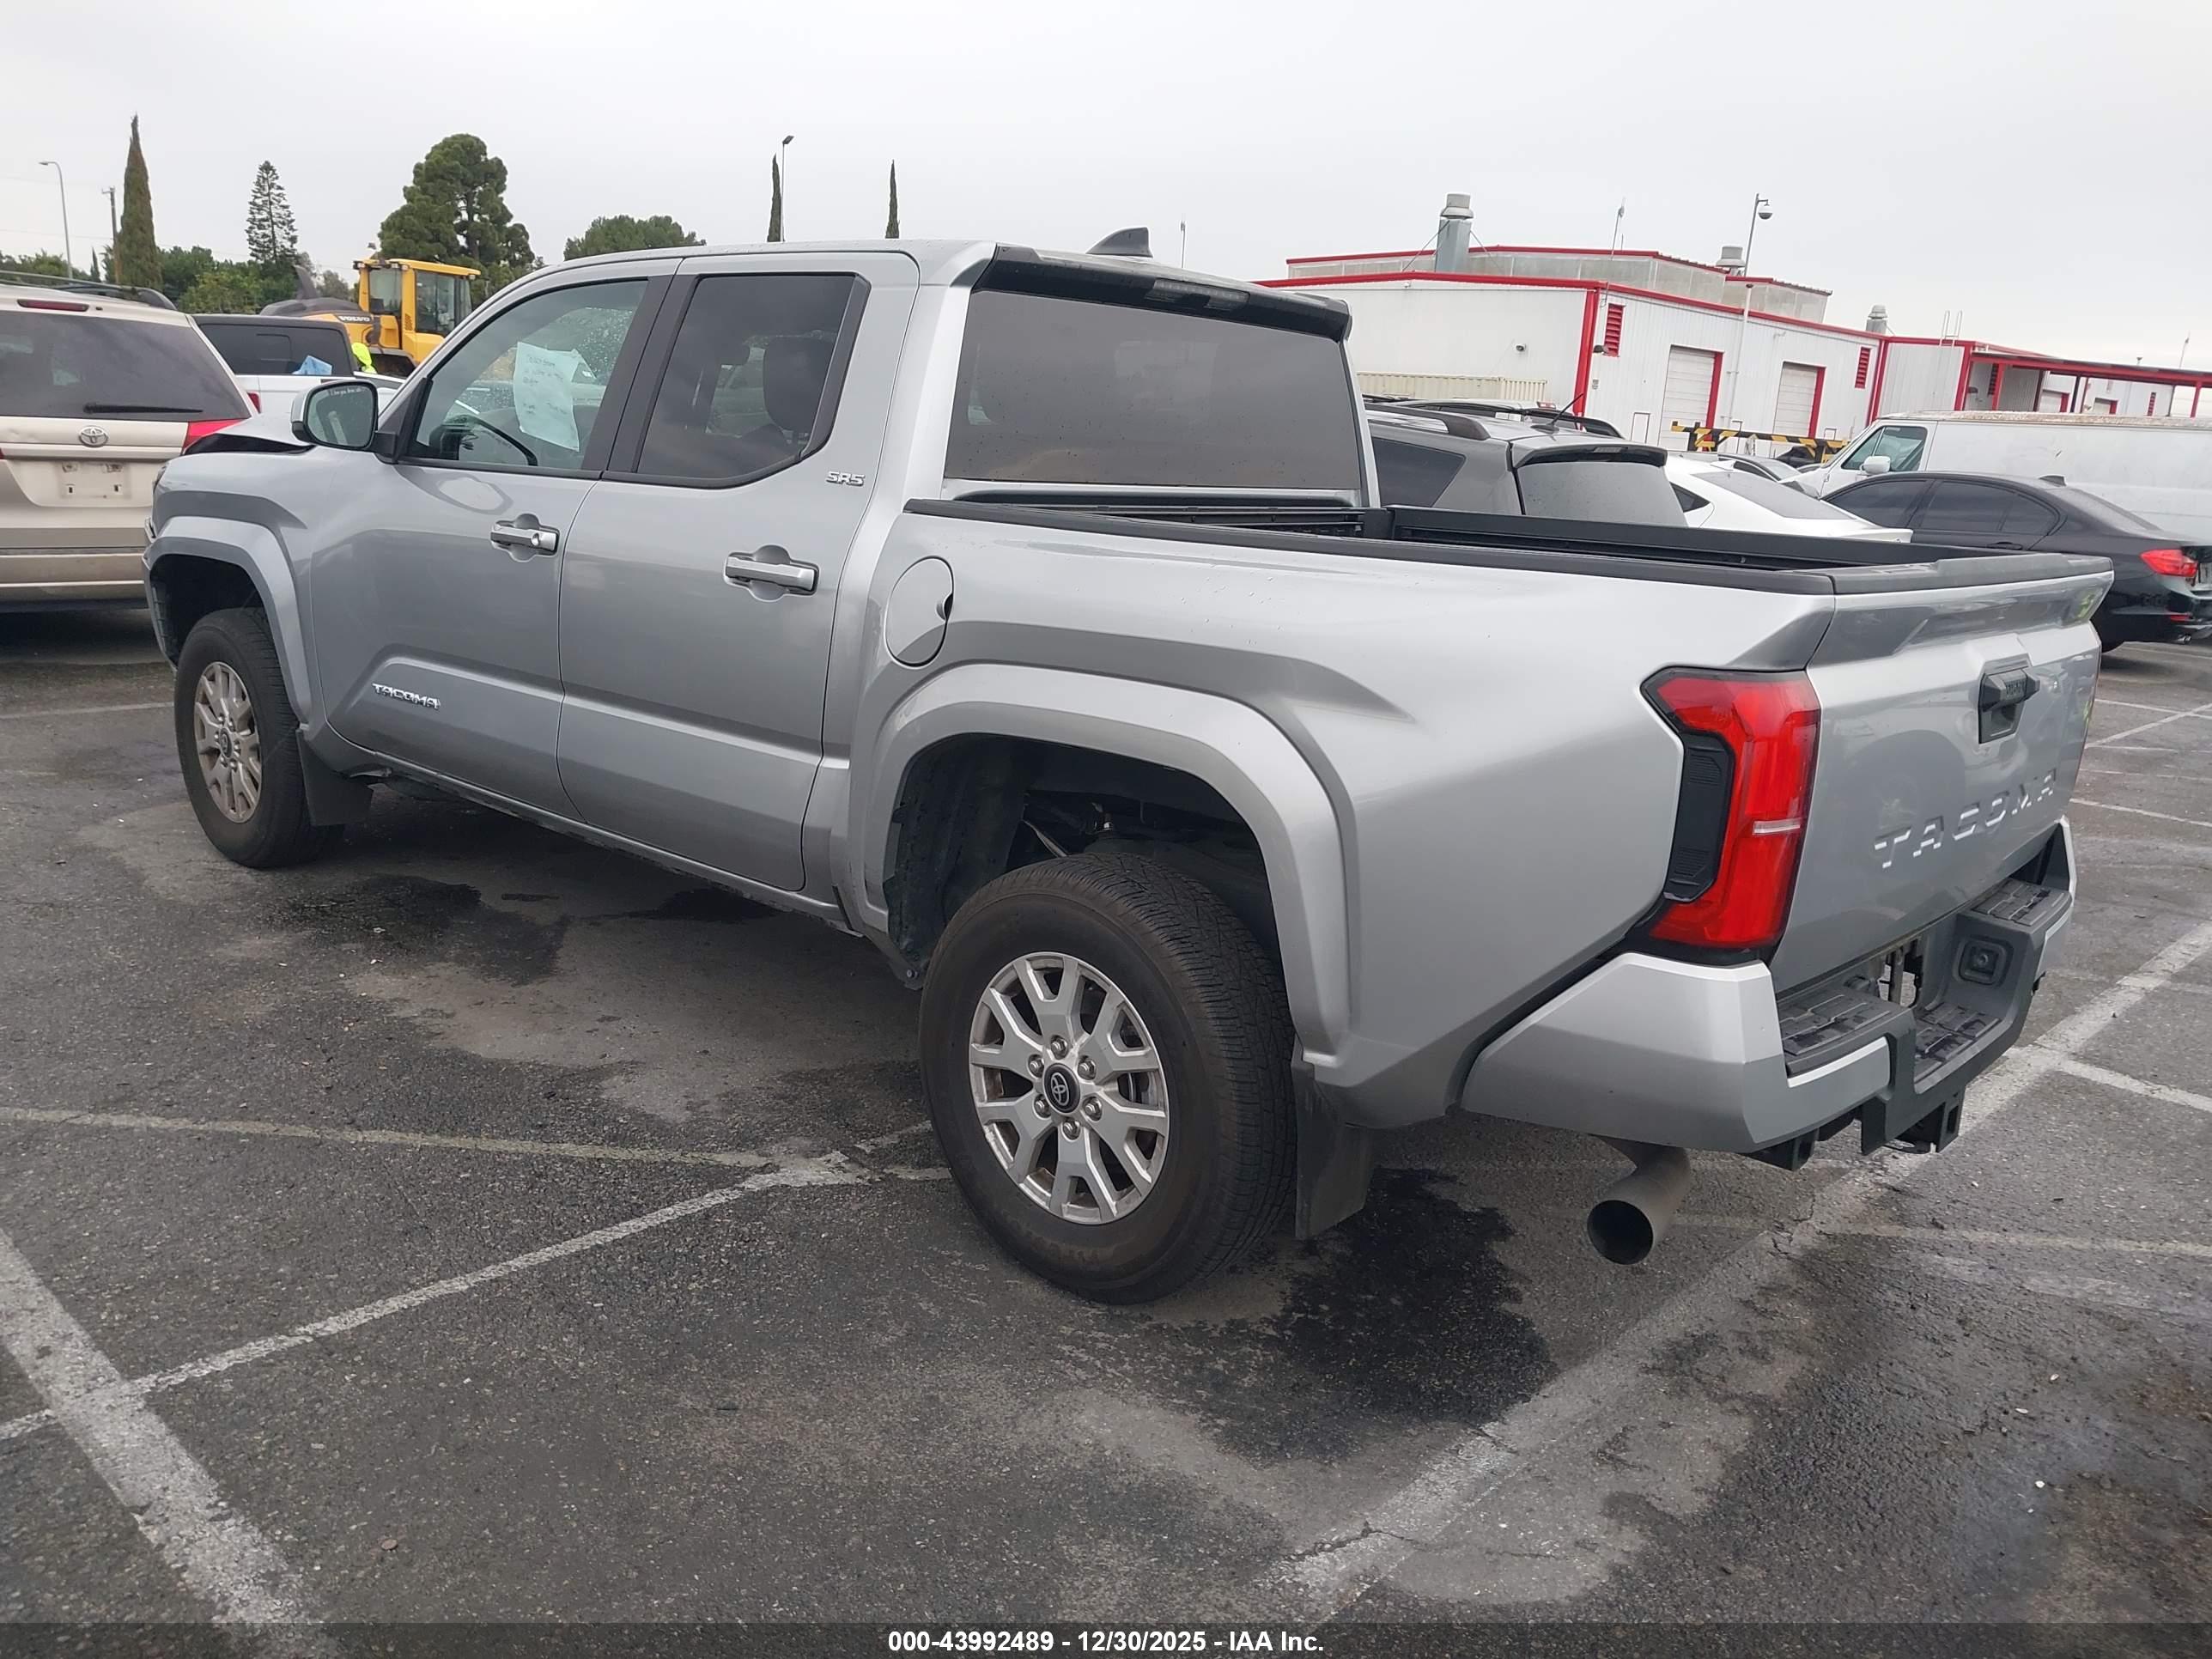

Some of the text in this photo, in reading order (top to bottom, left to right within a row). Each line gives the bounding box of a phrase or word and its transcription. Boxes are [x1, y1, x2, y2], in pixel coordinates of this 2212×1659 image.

[826, 471, 866, 487] SR5
[372, 683, 441, 709] TACOMA
[1875, 768, 2057, 868] TACOMA
